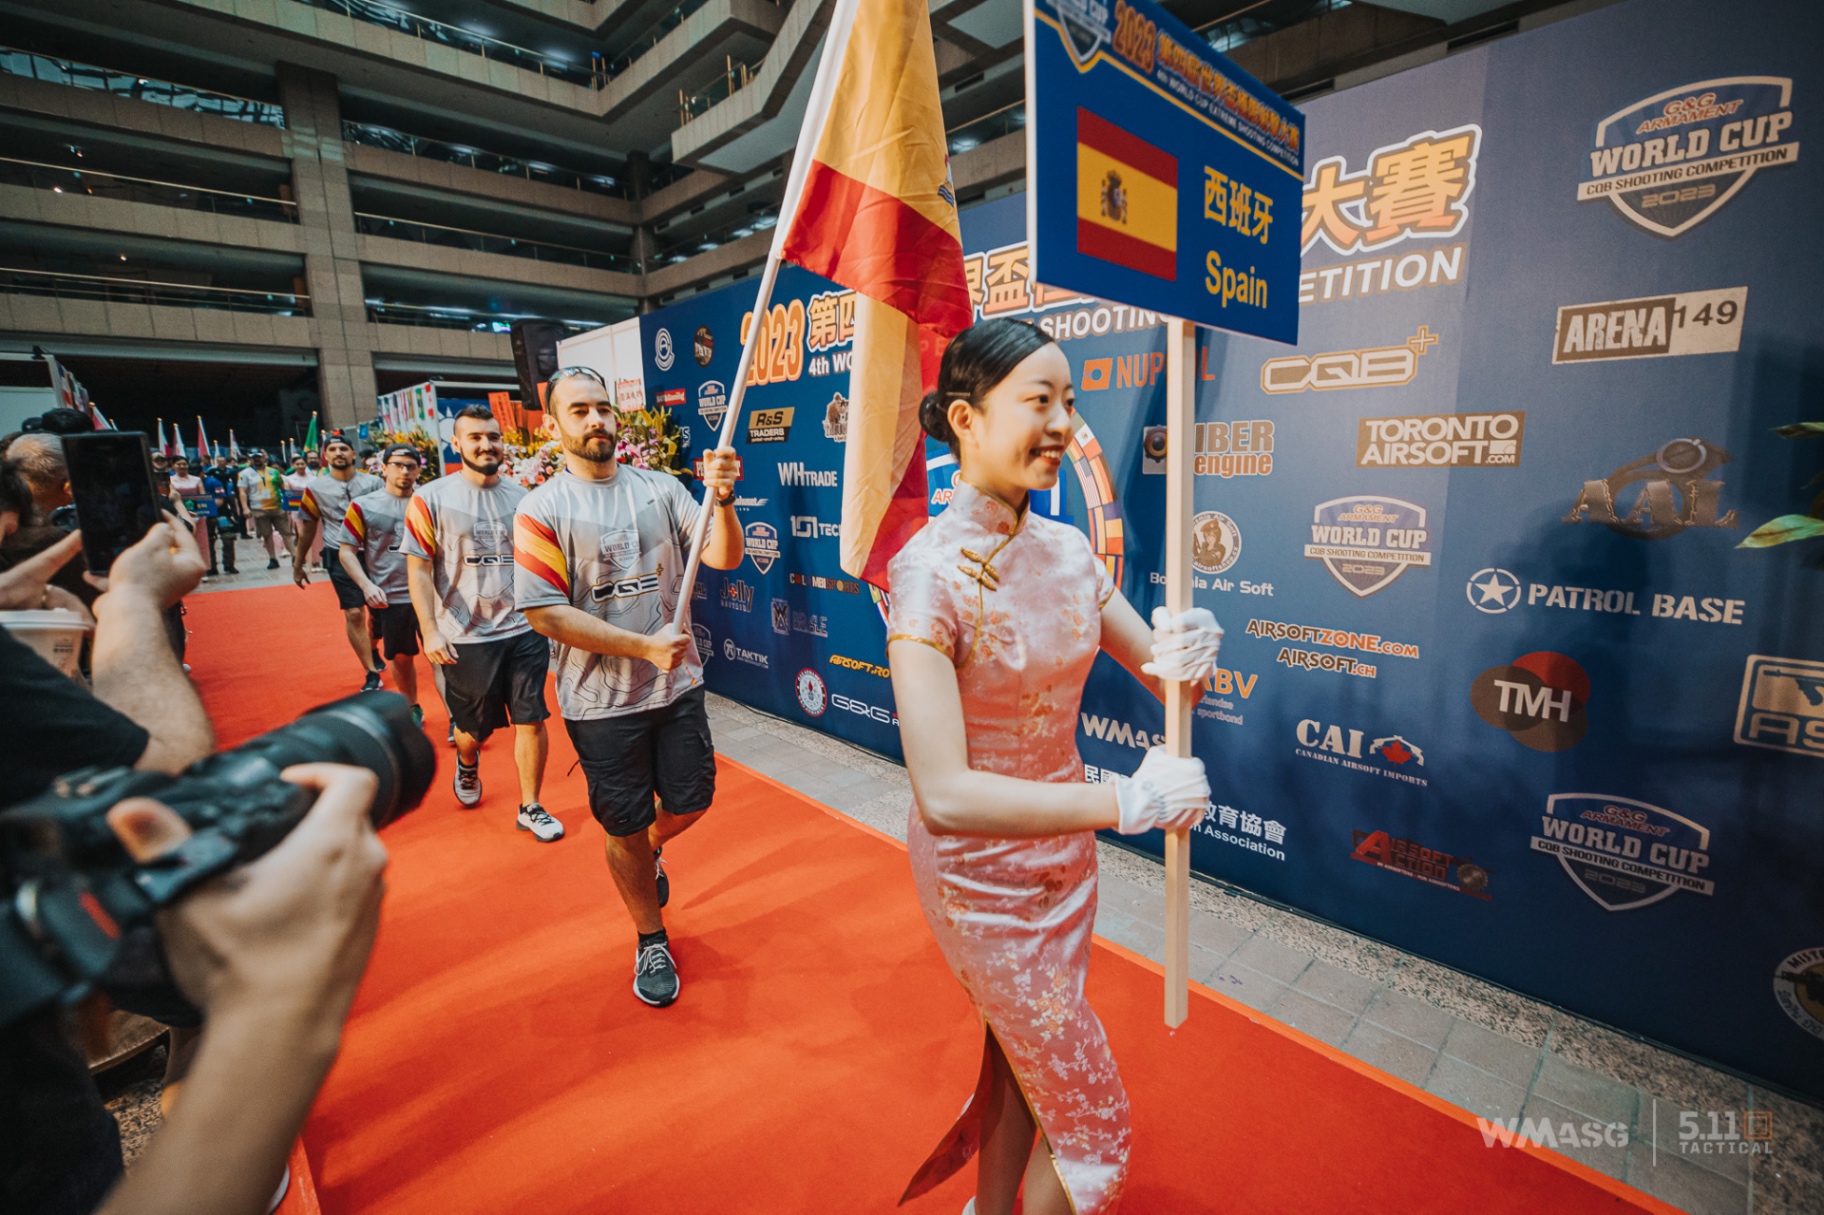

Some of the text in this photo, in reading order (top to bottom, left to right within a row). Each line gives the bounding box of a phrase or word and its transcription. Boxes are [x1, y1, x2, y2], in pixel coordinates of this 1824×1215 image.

[1112, 0, 1156, 74] 2023
[1636, 99, 1744, 135] ARMAMENT
[1663, 92, 1717, 117] G&G
[1590, 111, 1793, 178] WORLD CUP
[1586, 147, 1788, 196] CQB SHOOTING COMPETITION
[1204, 165, 1273, 245] 西班牙
[1301, 130, 1477, 250] 大賽
[1641, 183, 1716, 208] 2023
[1205, 250, 1268, 309] Spain
[1563, 300, 1738, 354] ARENA 149
[808, 356, 830, 377] 4th
[1116, 347, 1216, 388] NUPL
[749, 428, 785, 437] TRADERS
[756, 411, 784, 426] R&S
[1365, 414, 1519, 442] TORONTO
[1194, 454, 1274, 478] engine
[1360, 440, 1516, 465] AIRSOFT .COM
[1337, 513, 1398, 523] ARMAMENT
[1353, 504, 1383, 515] G&G
[1311, 525, 1427, 549] WORLD CUP
[1326, 548, 1367, 559] SHOOTING
[1367, 551, 1425, 563] COMPETITION
[1342, 563, 1385, 576] 2023
[1212, 578, 1235, 592] Air
[1239, 580, 1274, 597] Soft
[1528, 583, 1746, 625] PATROL BASE
[1246, 619, 1419, 659] AIRSOFTZONE.COM
[735, 647, 768, 665] TAKTIK
[1277, 648, 1377, 678] AIRSOFT.CH
[831, 694, 890, 724] G&G
[1494, 679, 1572, 723] TMH
[1081, 711, 1166, 752] WMAS
[1296, 718, 1364, 759] CAI
[1295, 748, 1428, 788] CANADIAN AIRSOFT IMPORTS
[1580, 811, 1670, 836] ARMAMENT
[1603, 804, 1649, 822] G&G
[1204, 824, 1287, 862] Association
[1541, 815, 1710, 874] WORLD CUP
[1562, 845, 1619, 869] SHOOTING
[1621, 860, 1705, 891] COMPETITION
[1584, 869, 1646, 894] 2023
